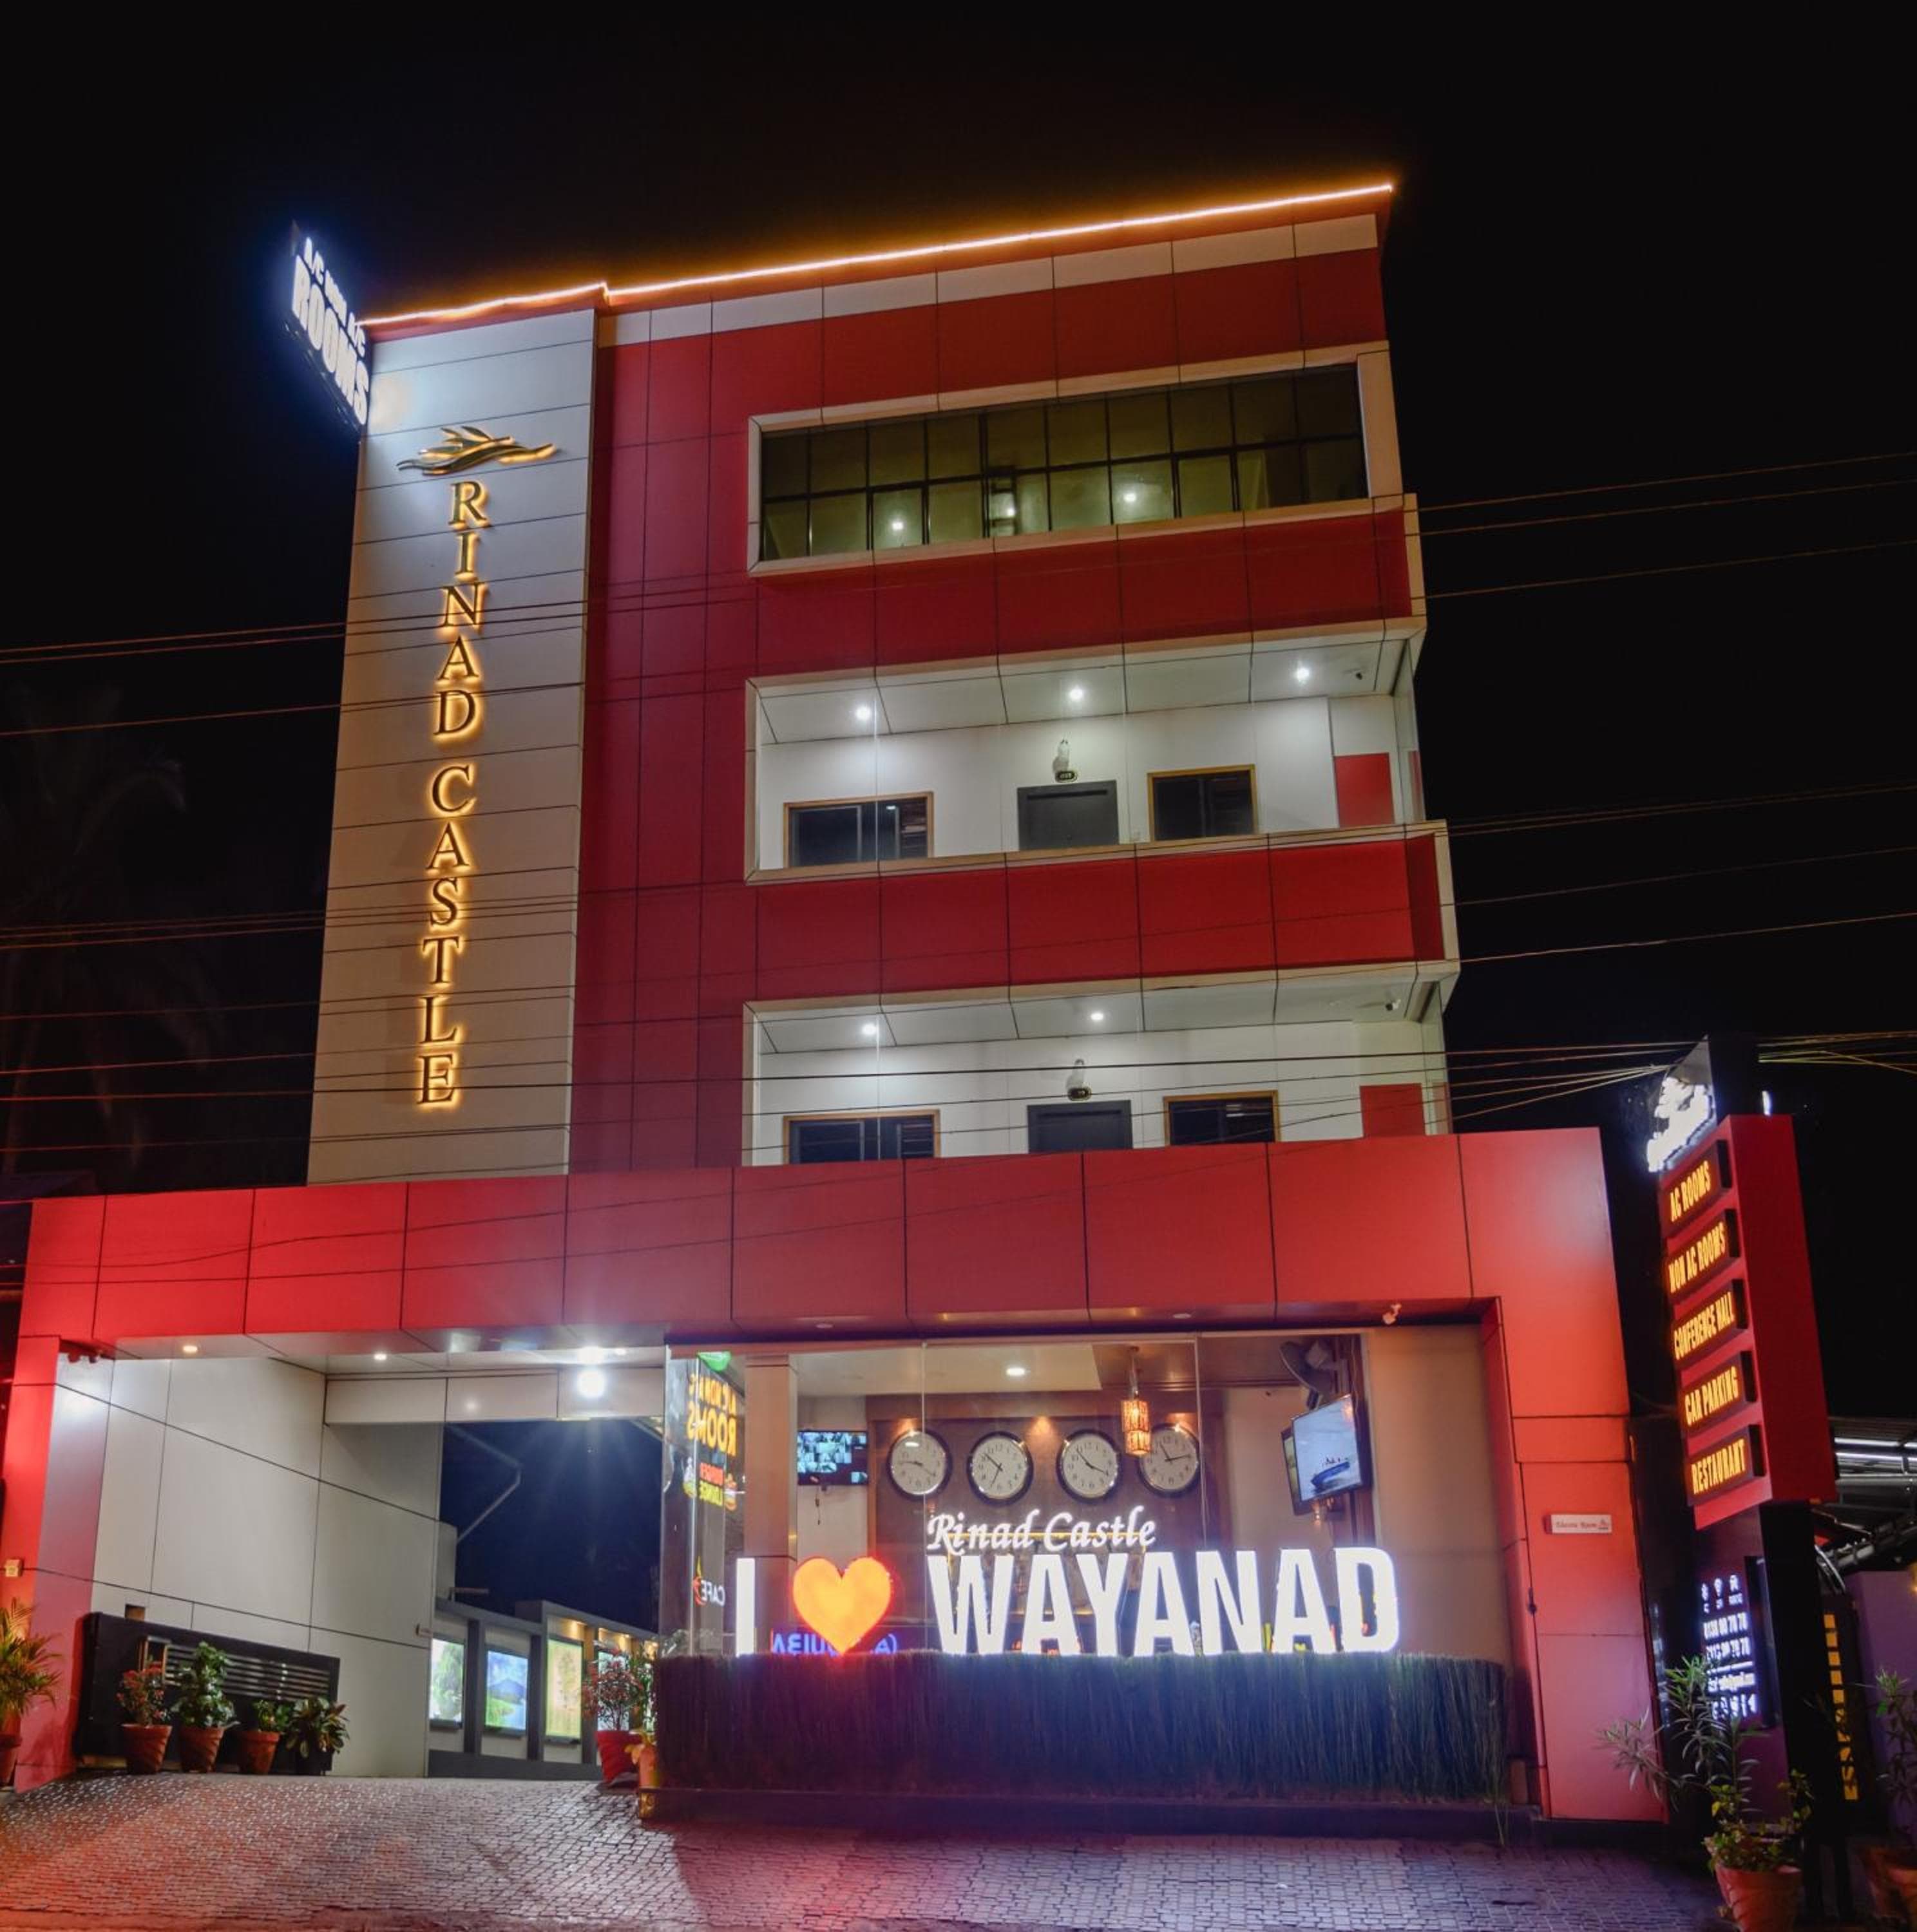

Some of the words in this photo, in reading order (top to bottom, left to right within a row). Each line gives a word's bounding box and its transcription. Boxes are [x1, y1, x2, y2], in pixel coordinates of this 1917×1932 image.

[292, 254, 370, 425] ROOMS
[433, 479, 491, 741] RINAD
[416, 764, 475, 1106] CASTLE
[1681, 1160, 1711, 1212] ROOMS
[1696, 1221, 1726, 1272] ROOMS
[1684, 1388, 1704, 1426] CAR
[1701, 1366, 1739, 1416] PARKING
[1691, 1438, 1745, 1495] RESTAURANT
[926, 1508, 1040, 1556] Rinad
[1042, 1504, 1156, 1551] Castle
[735, 1557, 756, 1657] I
[927, 1546, 1401, 1658] WAYANAD
